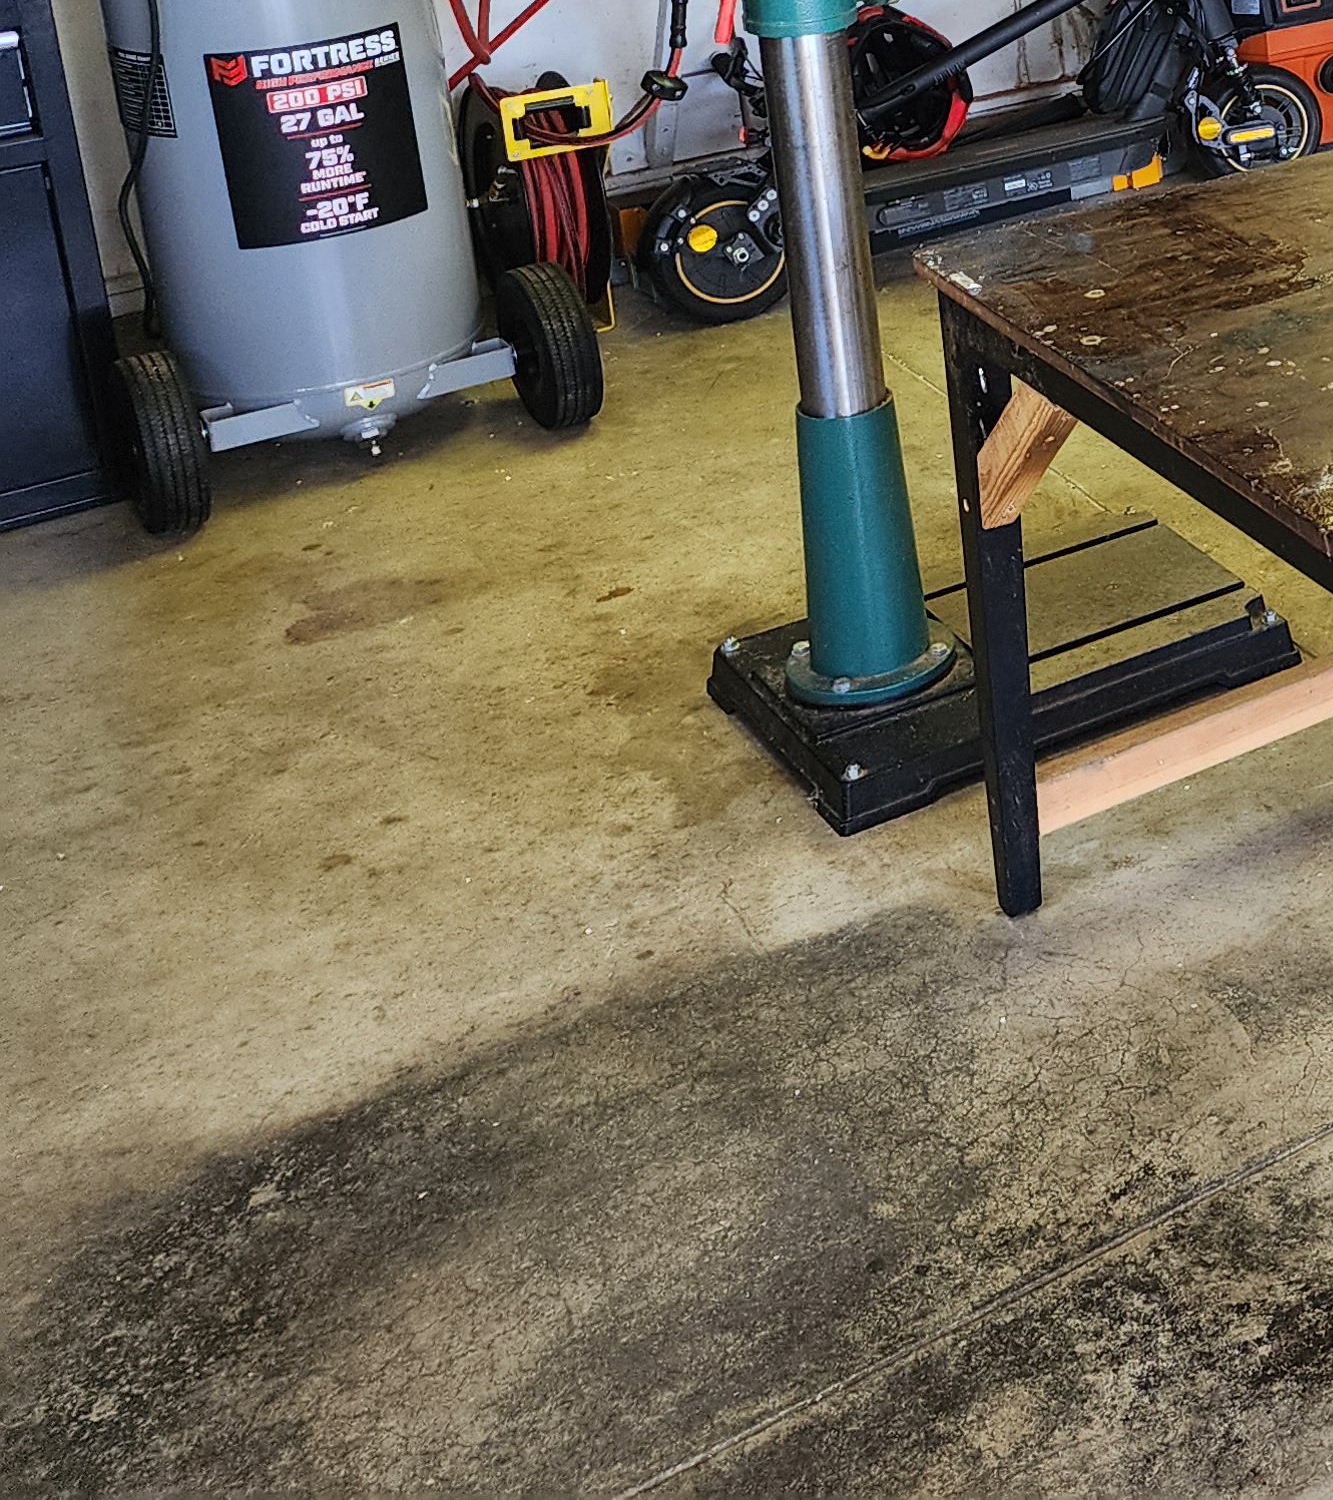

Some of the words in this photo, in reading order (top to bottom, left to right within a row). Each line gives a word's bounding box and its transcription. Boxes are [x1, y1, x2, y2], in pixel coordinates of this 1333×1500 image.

[250, 29, 398, 79] FORTRESS
[272, 87, 321, 111] 200
[326, 78, 363, 102] PSI
[279, 111, 312, 134] 27
[316, 102, 365, 127] GAL
[311, 138, 327, 149] up
[329, 133, 344, 145] to
[305, 144, 355, 170] 75%
[312, 162, 354, 181] MORE
[300, 219, 338, 234] COLD
[339, 206, 380, 226] START
